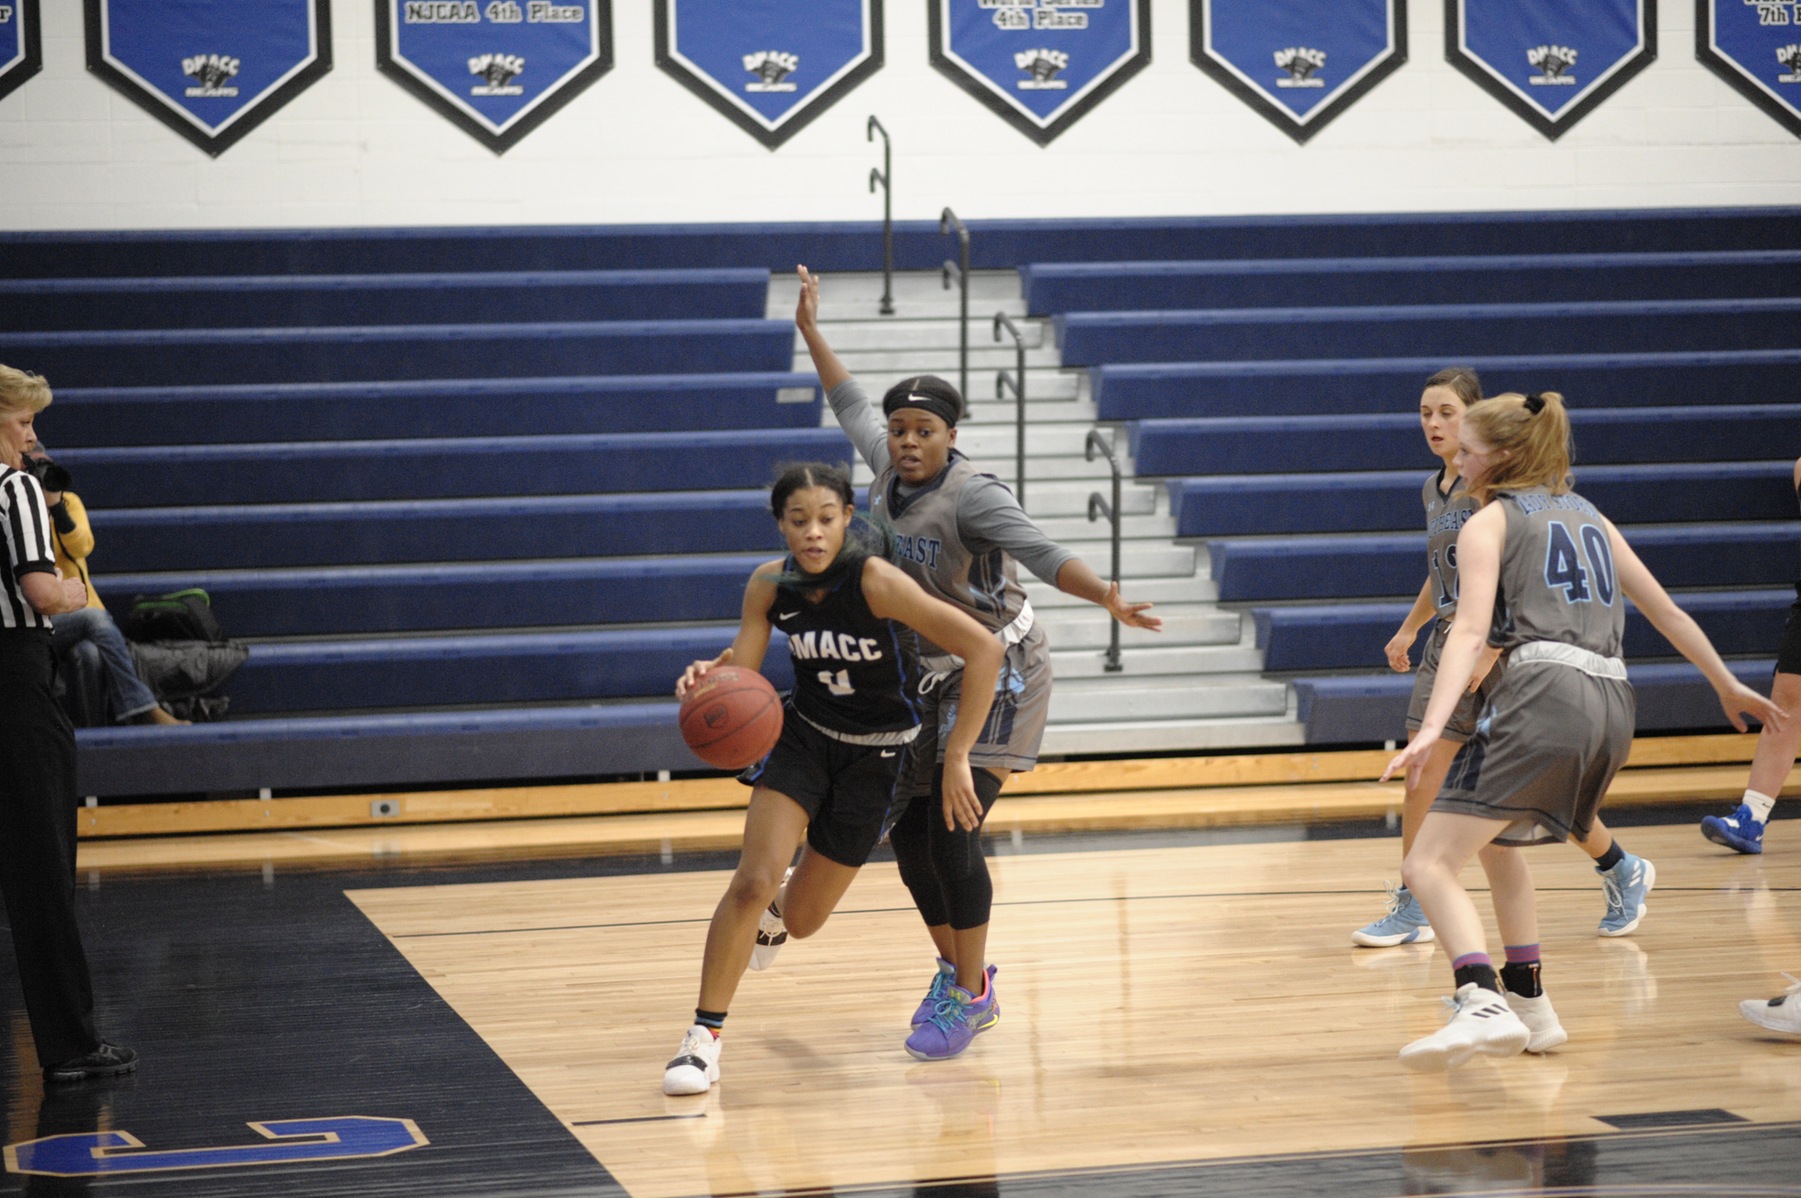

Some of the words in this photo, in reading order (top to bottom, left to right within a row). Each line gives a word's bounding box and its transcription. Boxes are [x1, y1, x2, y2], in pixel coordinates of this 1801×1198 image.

[406, 2, 479, 22] NJCAA
[486, 2, 522, 22] 4th
[528, 2, 584, 22] Place
[993, 9, 1029, 29] 4th
[1034, 8, 1088, 29] Place
[1758, 6, 1788, 25] 7th
[895, 534, 941, 571] EAST
[1544, 521, 1614, 607] 40
[789, 630, 882, 661] MACC
